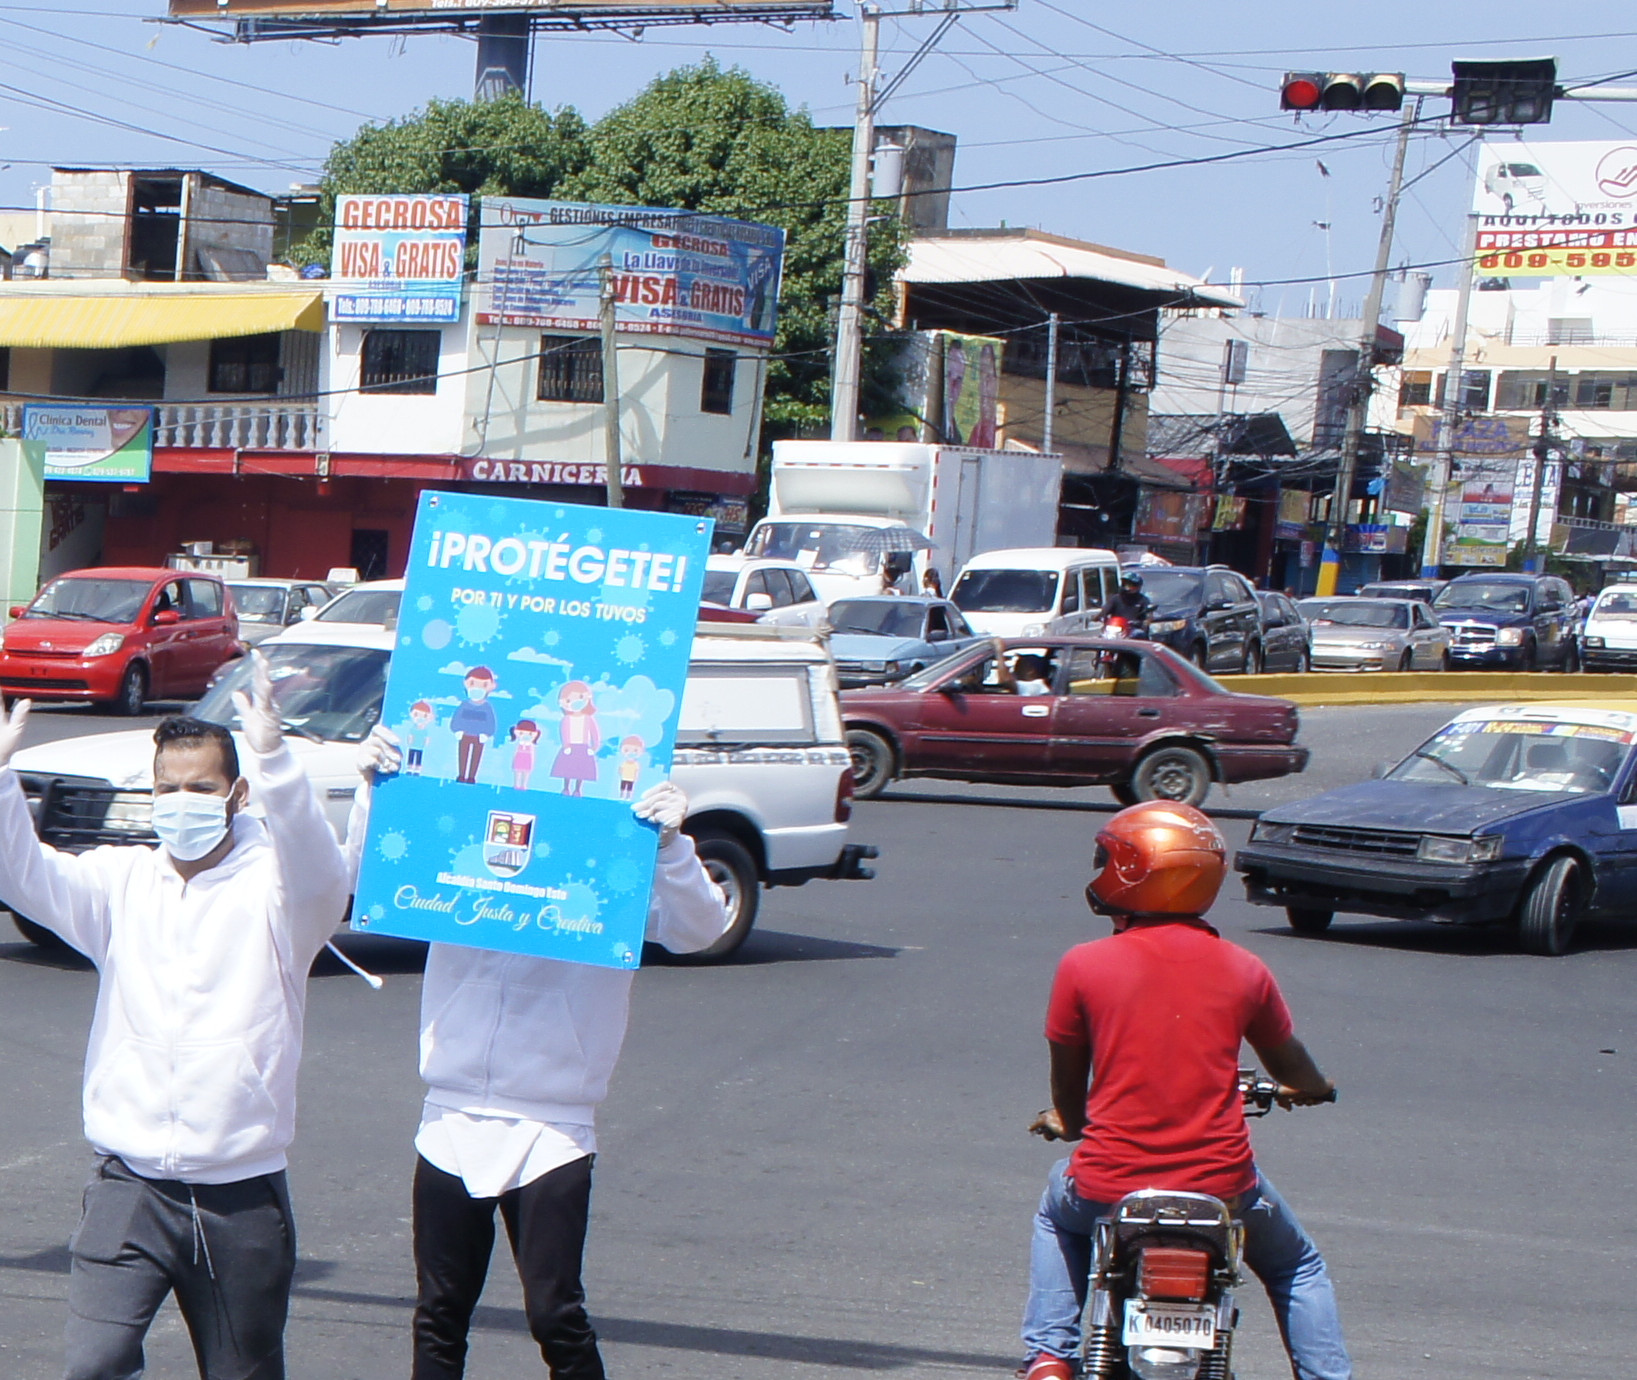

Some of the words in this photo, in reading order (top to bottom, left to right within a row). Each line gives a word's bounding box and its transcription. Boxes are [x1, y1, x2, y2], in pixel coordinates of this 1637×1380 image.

[343, 200, 461, 231] GECROSA
[1548, 212, 1623, 227] TODOS
[651, 234, 730, 257] GECROSA
[1479, 232, 1605, 248] PRESTAMO
[341, 242, 380, 278] VISA
[383, 260, 391, 278] &
[395, 241, 459, 279] GRATIS
[624, 251, 640, 269] La
[746, 256, 774, 290] VISA
[612, 275, 679, 306] VISA
[690, 280, 745, 317] GRATIS
[75, 415, 107, 427] Dental
[426, 530, 687, 593] ¡PROTÉGETE!
[450, 587, 486, 607] POR
[489, 591, 504, 608] TI
[506, 593, 520, 609] Y
[520, 595, 555, 614] POR
[559, 600, 591, 618] LOS
[595, 603, 647, 624] TUYOS
[393, 884, 463, 914] Ciudad
[454, 896, 515, 926] Justa
[512, 912, 531, 932] y
[536, 904, 605, 935] Creativa
[1128, 1314, 1140, 1334] K
